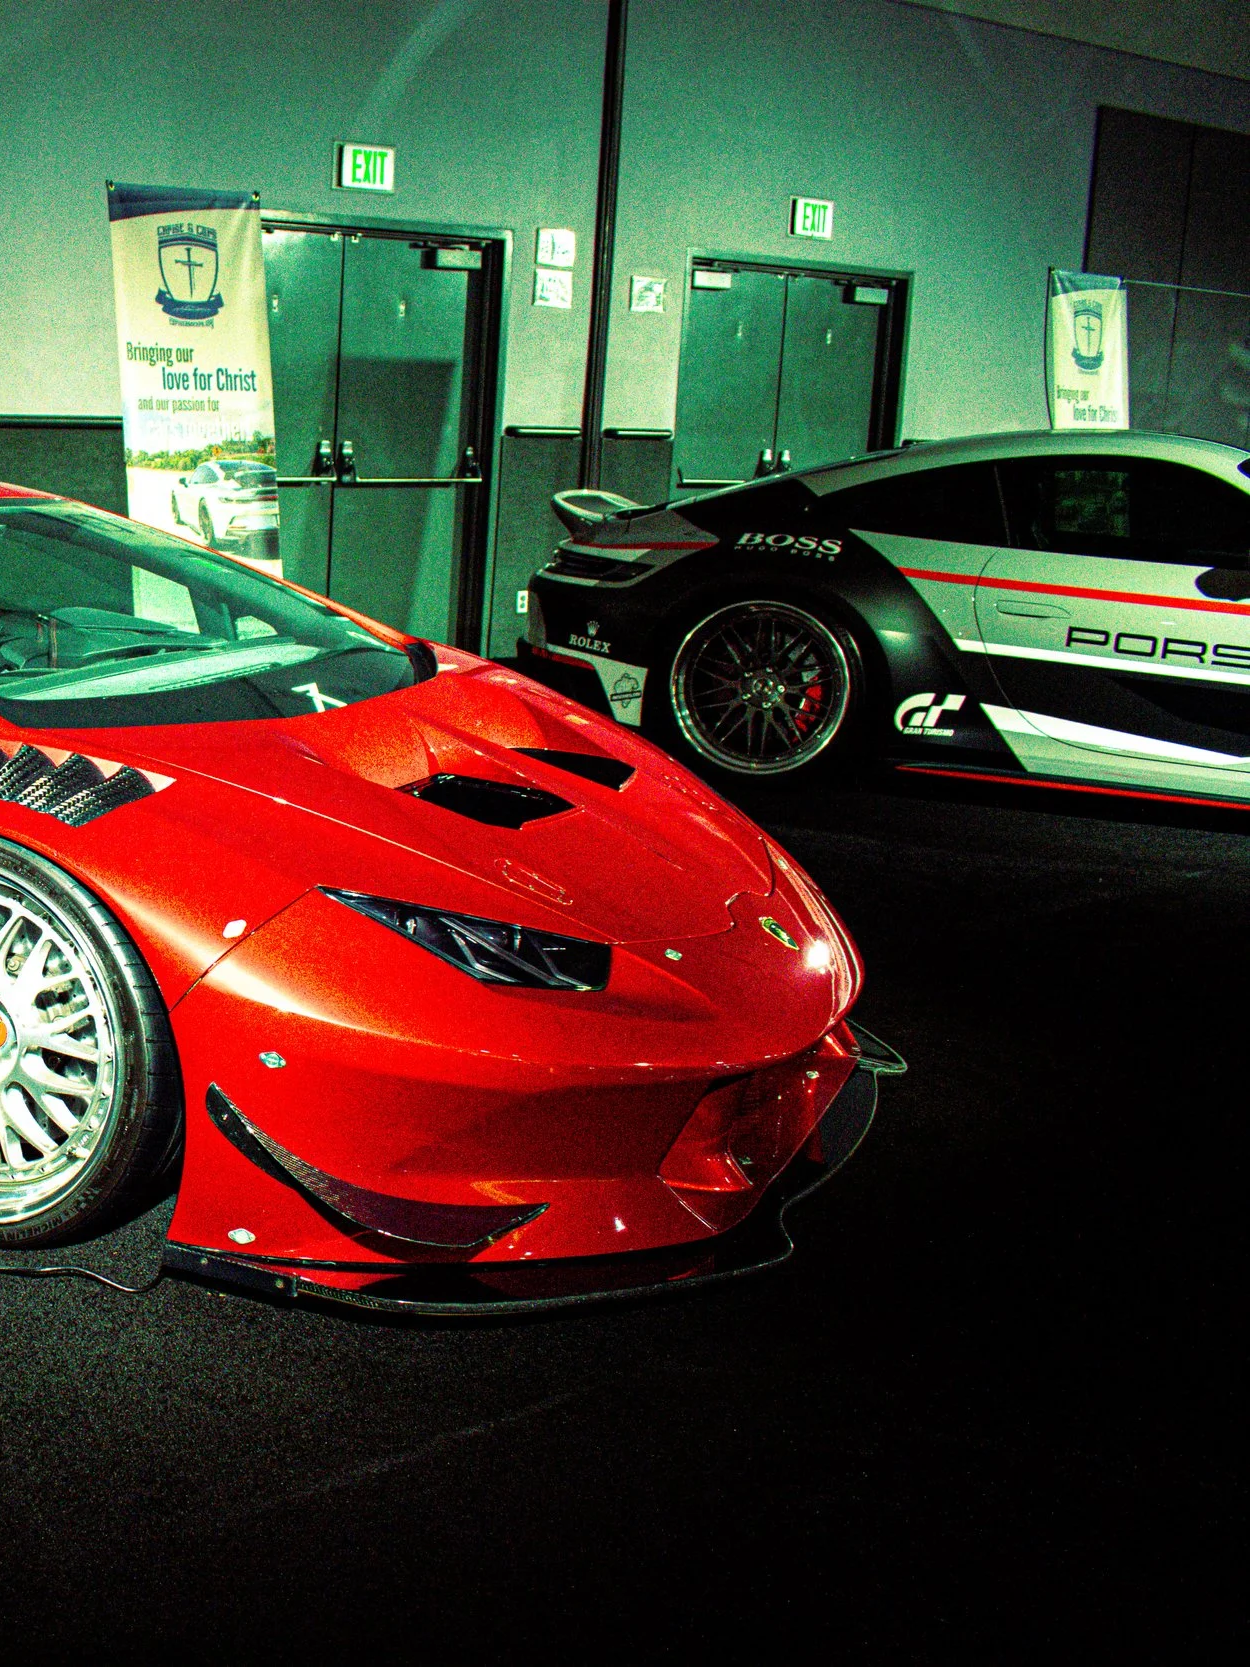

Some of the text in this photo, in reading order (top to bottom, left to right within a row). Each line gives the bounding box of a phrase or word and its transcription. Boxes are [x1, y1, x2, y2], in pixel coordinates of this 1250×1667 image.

[352, 149, 388, 184] EXIT
[803, 202, 828, 232] EXIT
[126, 342, 194, 367] Bringing our
[162, 367, 257, 392] love for Christ
[138, 396, 220, 413] and our passion for
[737, 533, 843, 554] BOSS
[569, 634, 611, 654] ROLEX
[903, 726, 924, 735] GRAN
